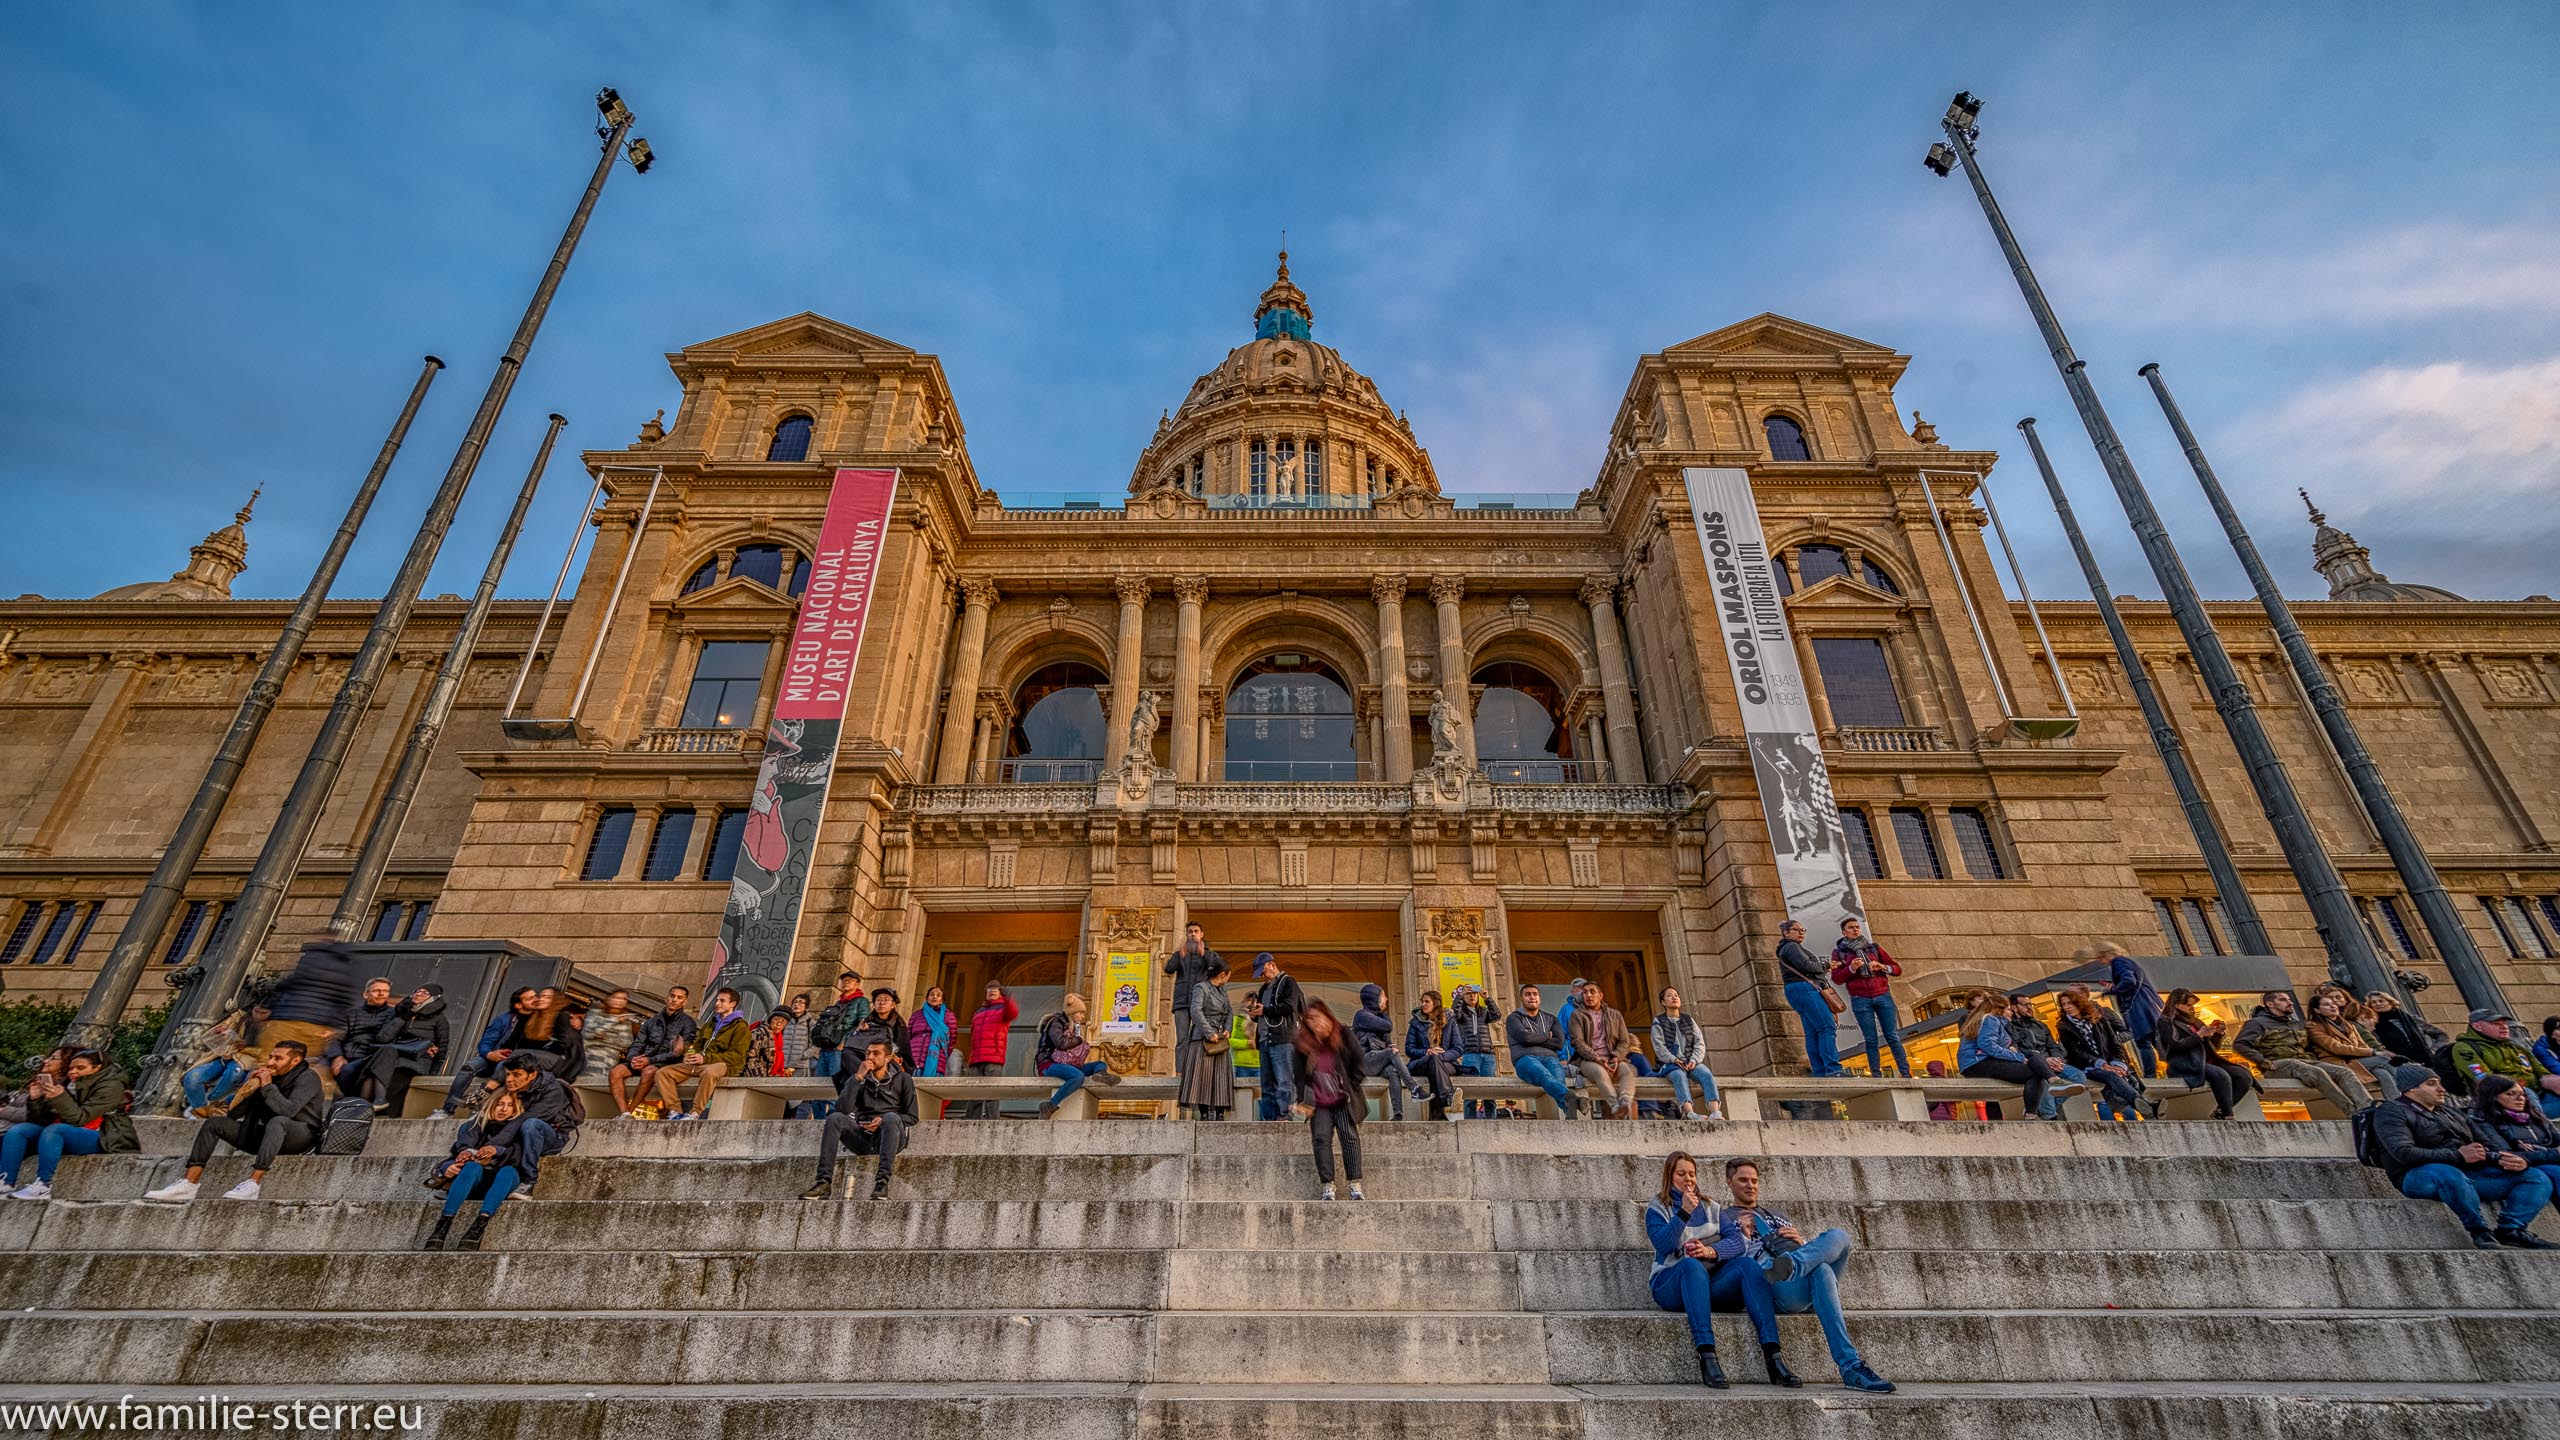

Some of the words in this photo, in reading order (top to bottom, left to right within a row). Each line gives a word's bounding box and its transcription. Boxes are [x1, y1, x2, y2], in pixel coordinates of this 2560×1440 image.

[838, 519, 880, 612] CATALUNYA
[1703, 511, 1749, 624] MASPONS
[1743, 564, 1782, 626] FOTOGRAFIA
[784, 639, 822, 702] MUSEU
[803, 548, 845, 633] NACIONAL
[831, 619, 857, 641] DE
[1759, 628, 1785, 641] LA
[816, 649, 850, 702] D'ART
[1730, 627, 1767, 705] ORIOL
[1770, 674, 1798, 687] 1949
[1775, 692, 1802, 706] 1995
